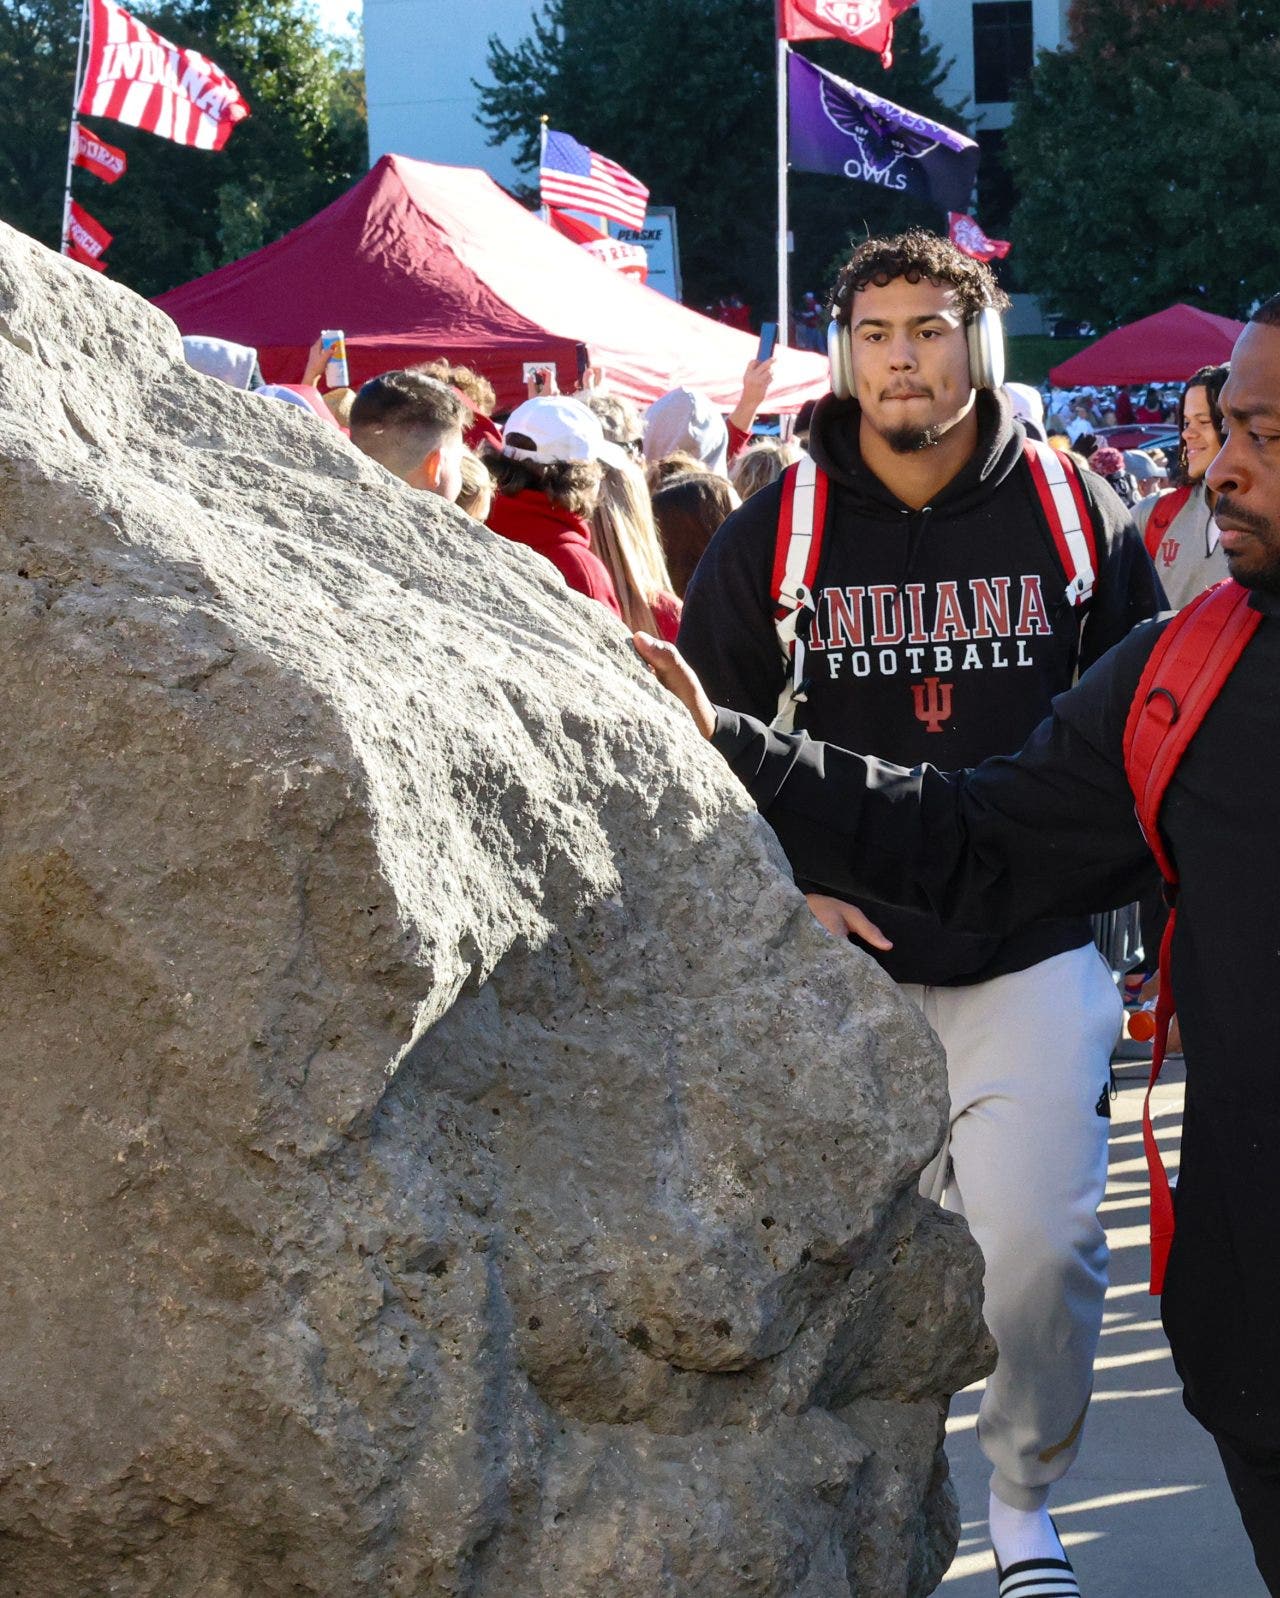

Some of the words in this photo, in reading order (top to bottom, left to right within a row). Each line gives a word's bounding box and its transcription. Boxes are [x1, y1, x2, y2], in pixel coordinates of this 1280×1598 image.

[844, 159, 907, 189] OWLS
[809, 575, 1053, 650] INDIANA
[827, 641, 1033, 679] FOOTBALL
